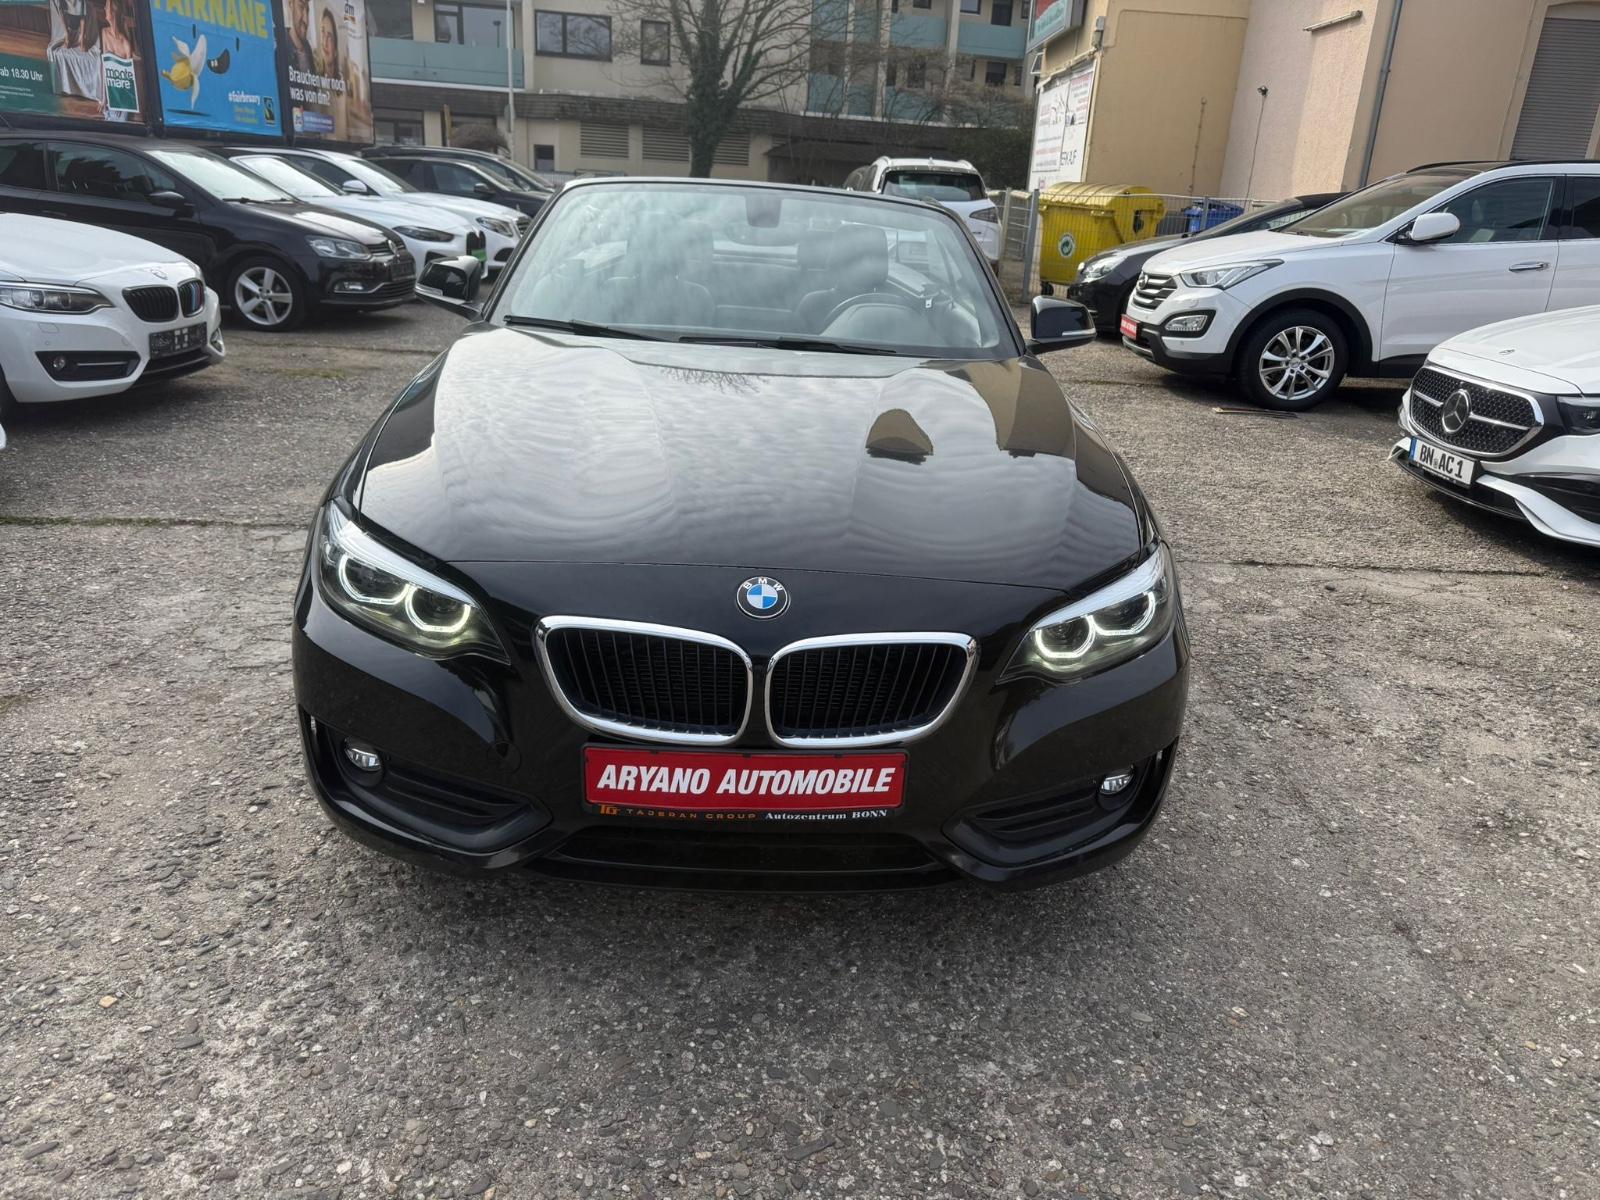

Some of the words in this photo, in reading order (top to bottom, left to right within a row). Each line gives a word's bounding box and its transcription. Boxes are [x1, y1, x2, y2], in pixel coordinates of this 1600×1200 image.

[30, 70, 43, 81] Uhr
[106, 77, 131, 89] mare
[288, 65, 321, 87] Brauchen
[321, 74, 330, 89] wir
[331, 75, 346, 91] noch
[290, 87, 304, 101] was
[304, 89, 316, 103] von
[1420, 444, 1434, 466] BN
[1439, 453, 1455, 474] AC
[1455, 460, 1464, 479] 1
[742, 576, 784, 591] BMW
[597, 764, 711, 795] ARYANO
[716, 767, 896, 796] AUTOMOBILE
[765, 811, 847, 821] Autozentrum
[852, 809, 888, 819] BONN
